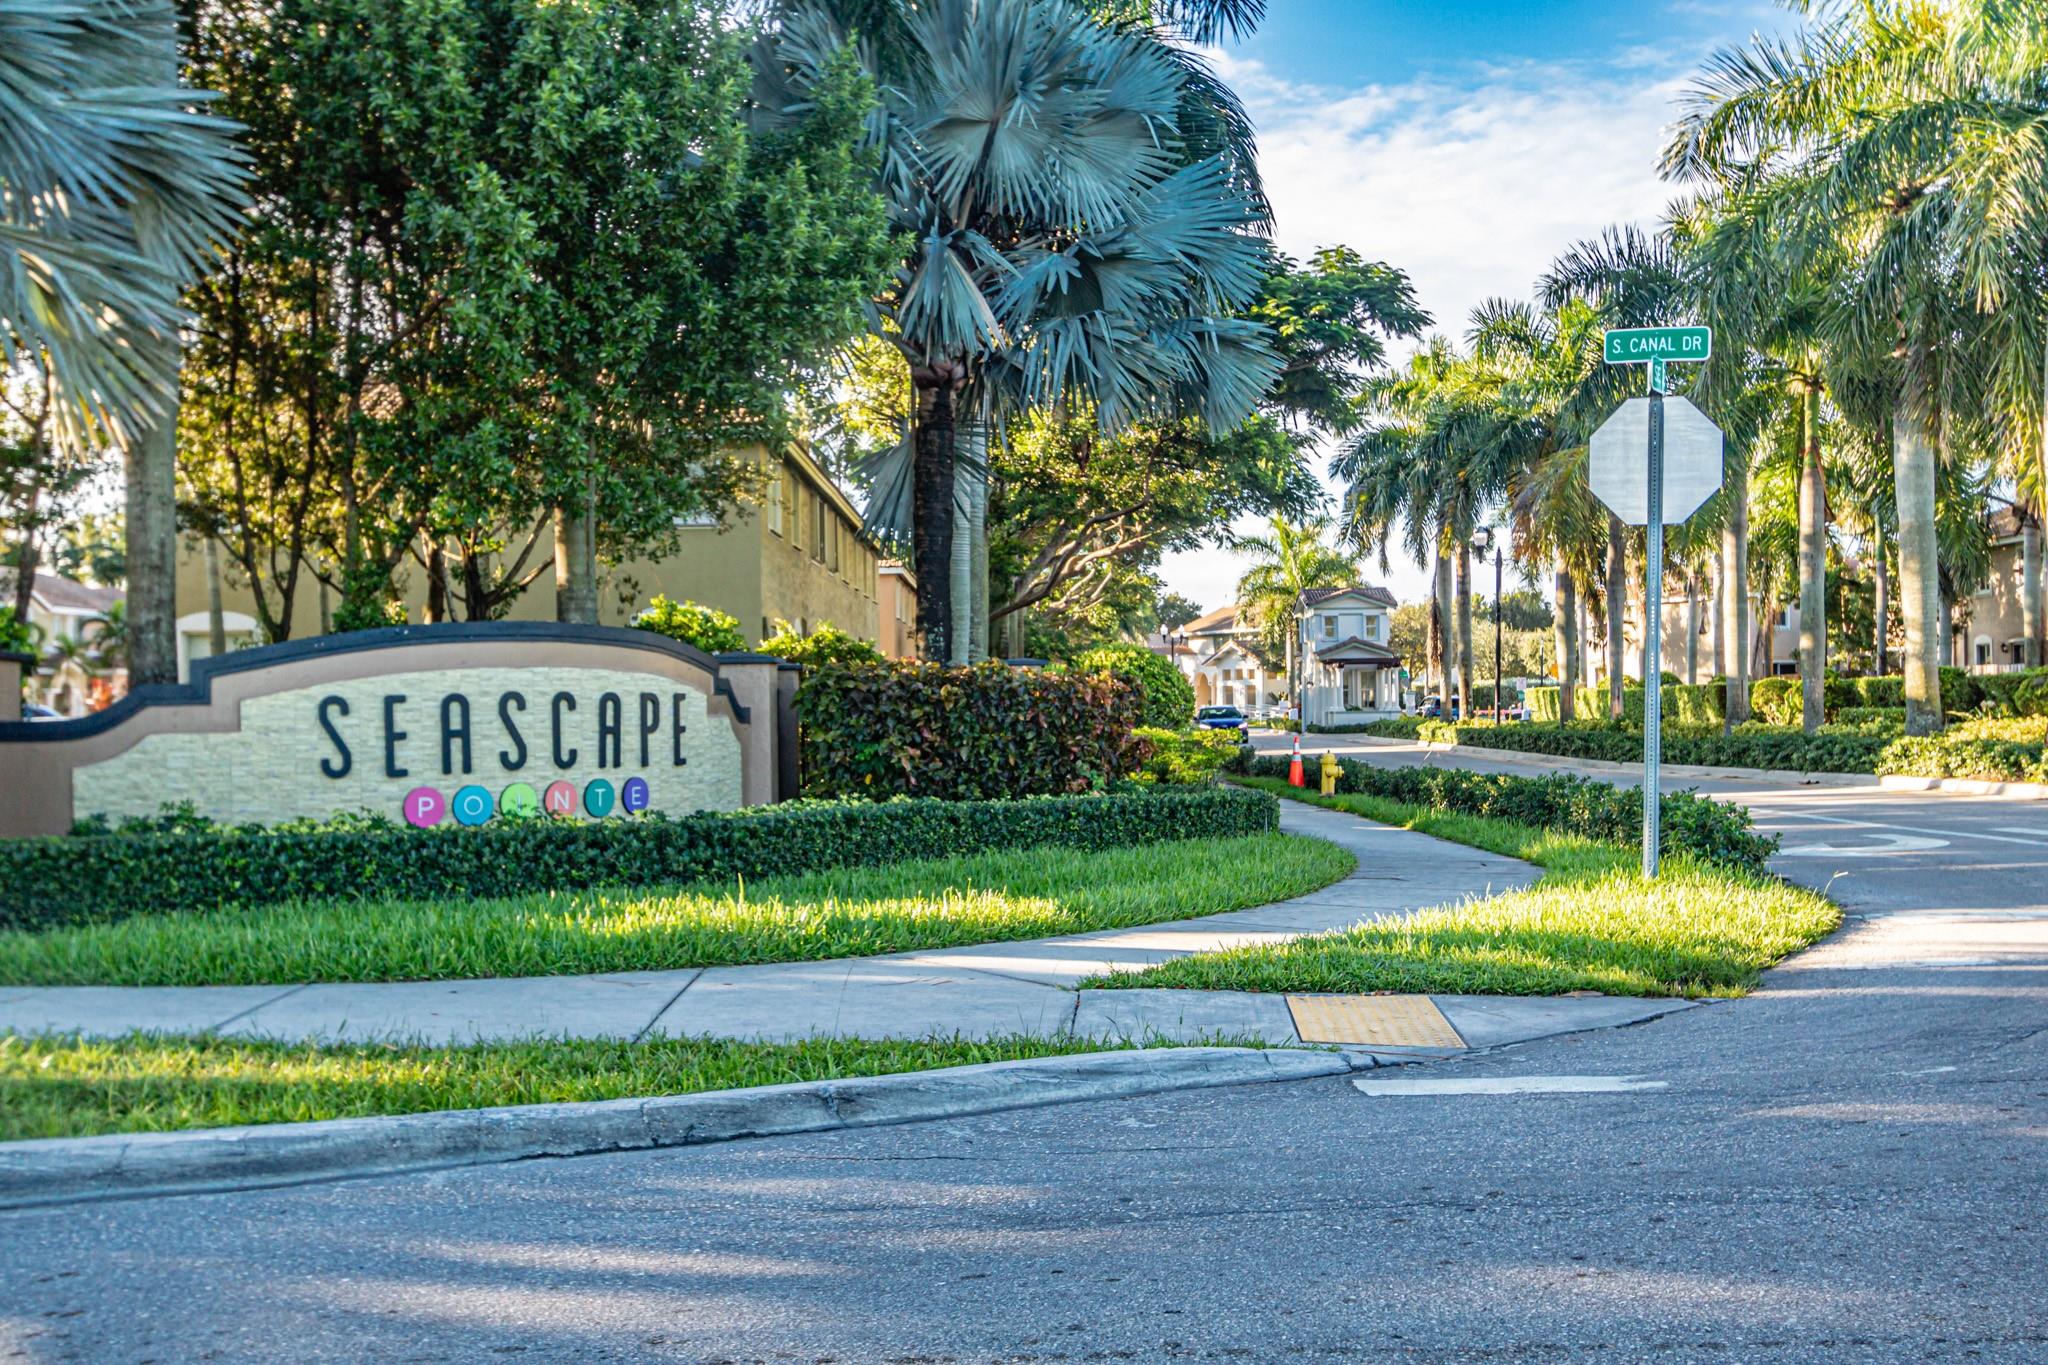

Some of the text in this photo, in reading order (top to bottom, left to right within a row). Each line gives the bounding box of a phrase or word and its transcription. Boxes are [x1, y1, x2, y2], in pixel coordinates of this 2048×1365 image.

[1612, 335, 1702, 354] S. CANAL DR
[317, 690, 688, 780] SEASCAPE
[416, 785, 643, 817] POINTE
